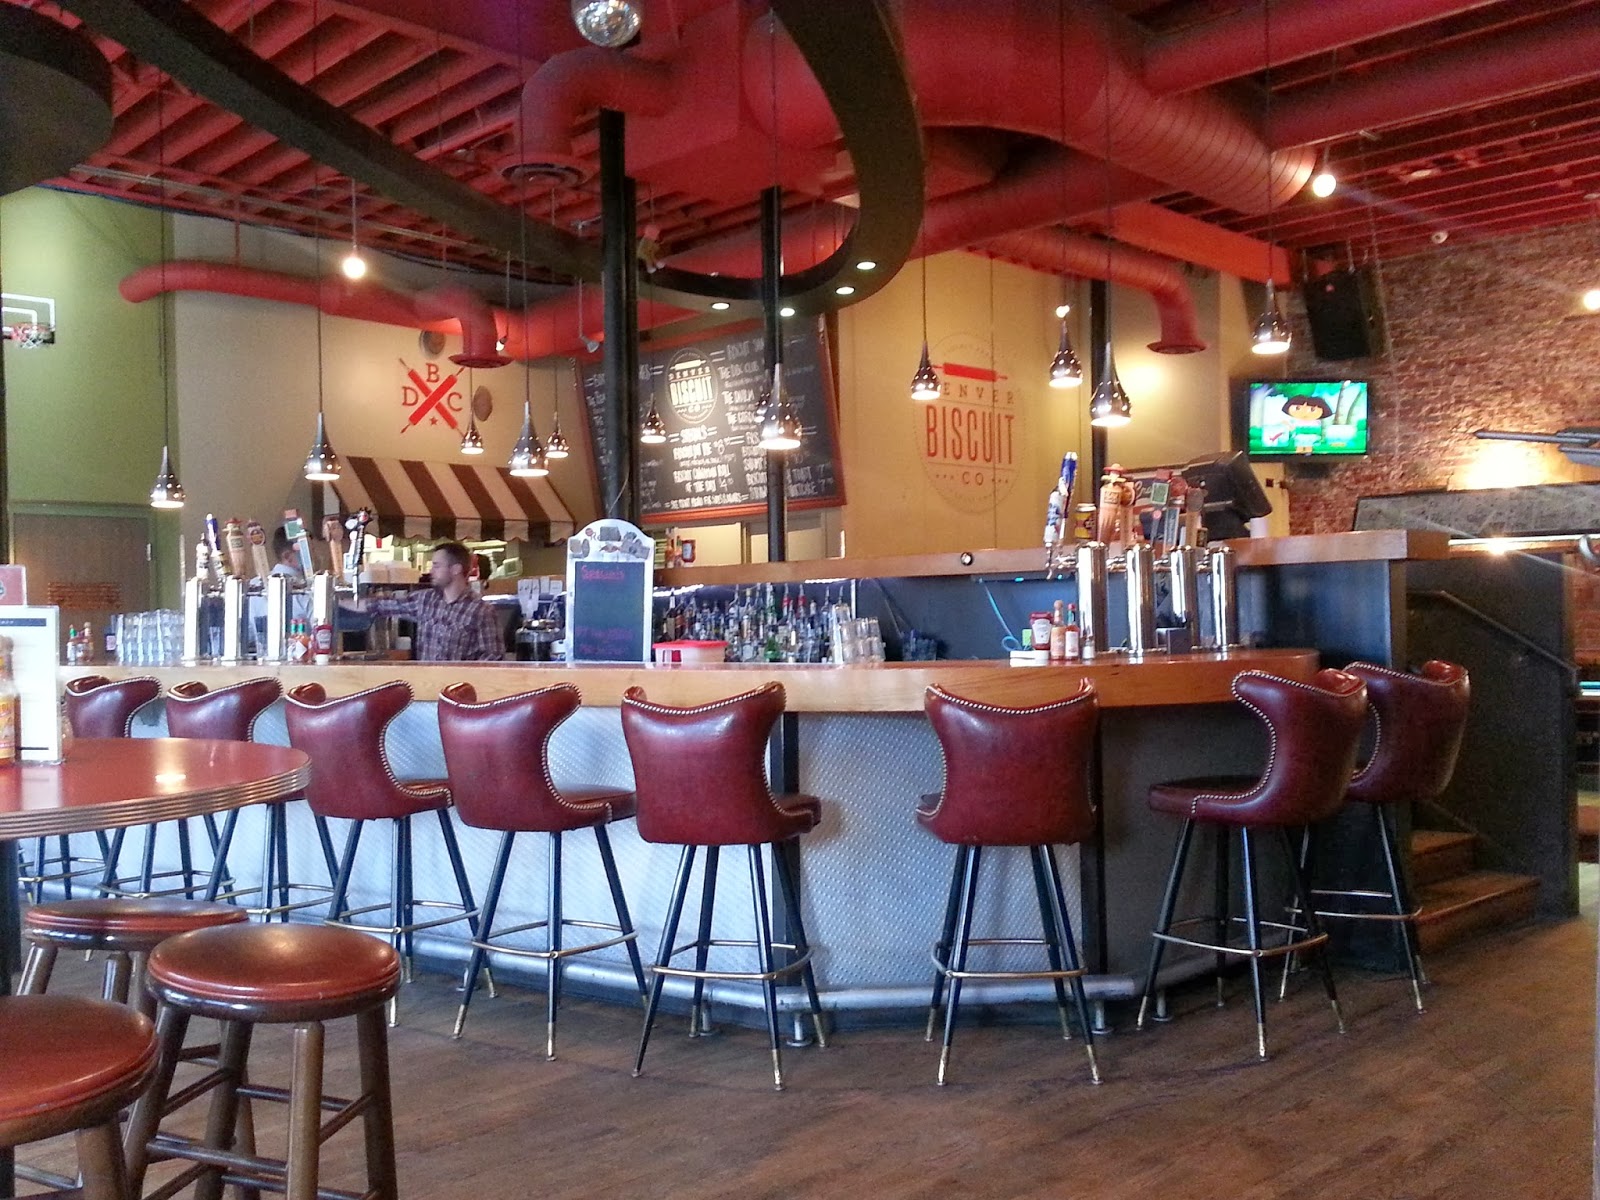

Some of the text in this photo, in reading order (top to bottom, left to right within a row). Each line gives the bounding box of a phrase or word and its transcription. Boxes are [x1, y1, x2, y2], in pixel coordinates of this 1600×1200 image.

[669, 376, 713, 405] BISCUIT
[943, 382, 1015, 405] ENVER
[925, 404, 1015, 464] BISCUIT
[961, 471, 985, 486] CO
